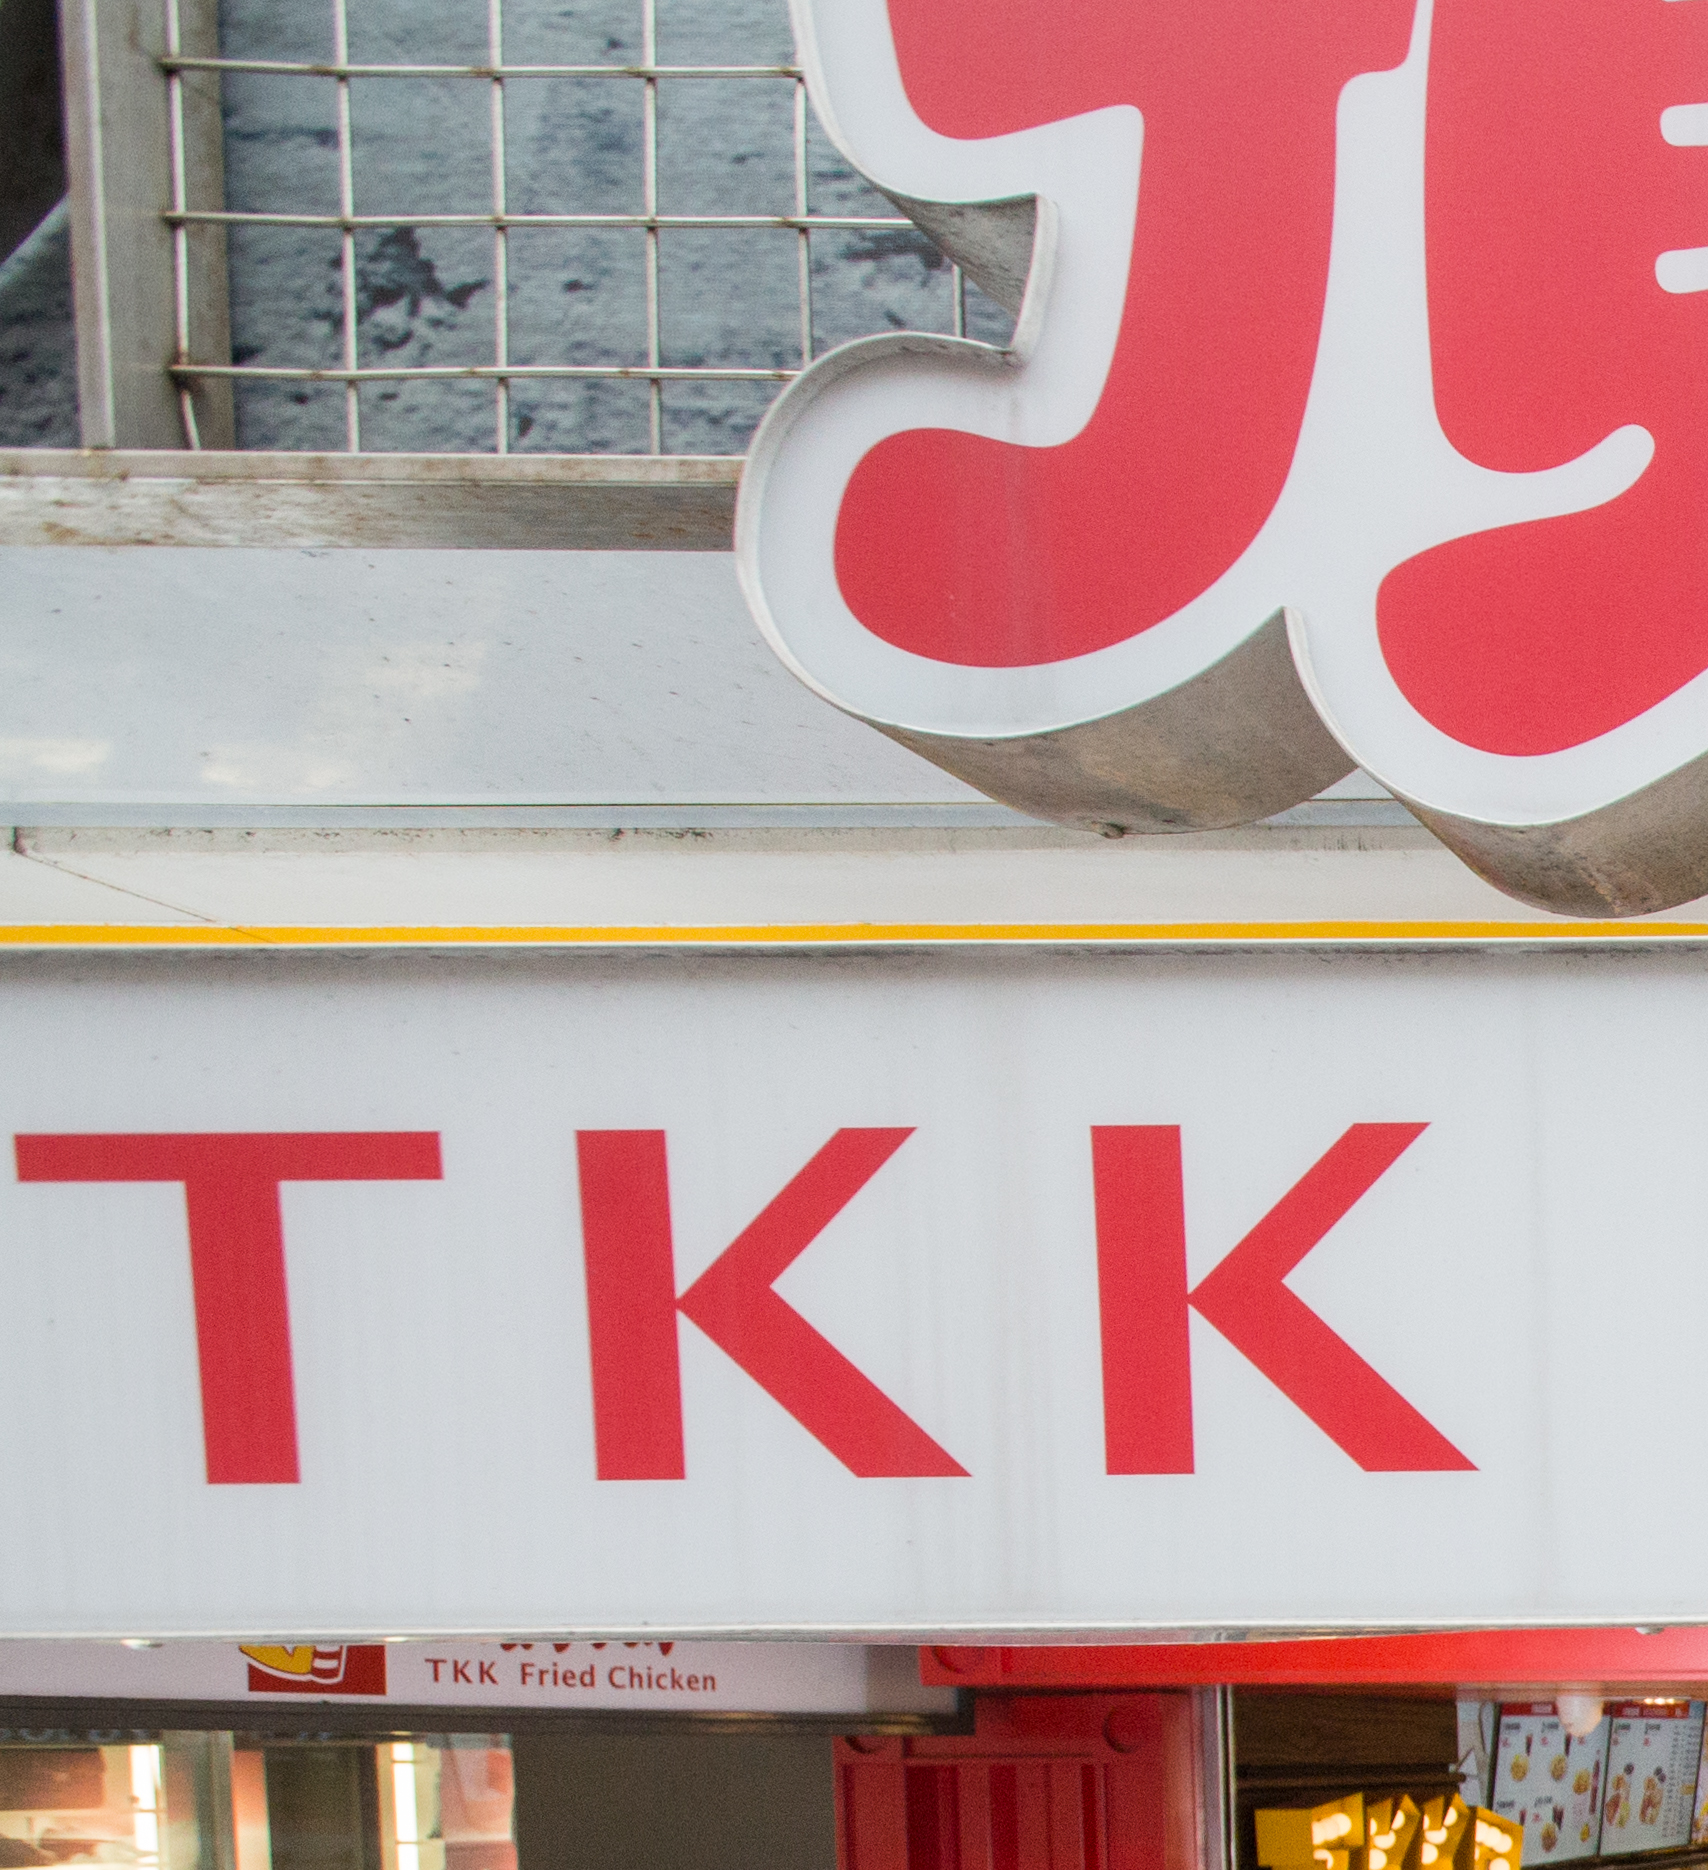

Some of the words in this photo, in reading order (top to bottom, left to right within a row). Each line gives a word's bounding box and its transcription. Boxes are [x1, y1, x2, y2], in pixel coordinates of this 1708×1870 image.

[14, 1123, 1478, 1484] TKK
[425, 1658, 499, 1685] TKK
[520, 1661, 597, 1689] Fried
[608, 1663, 718, 1692] Chicken
